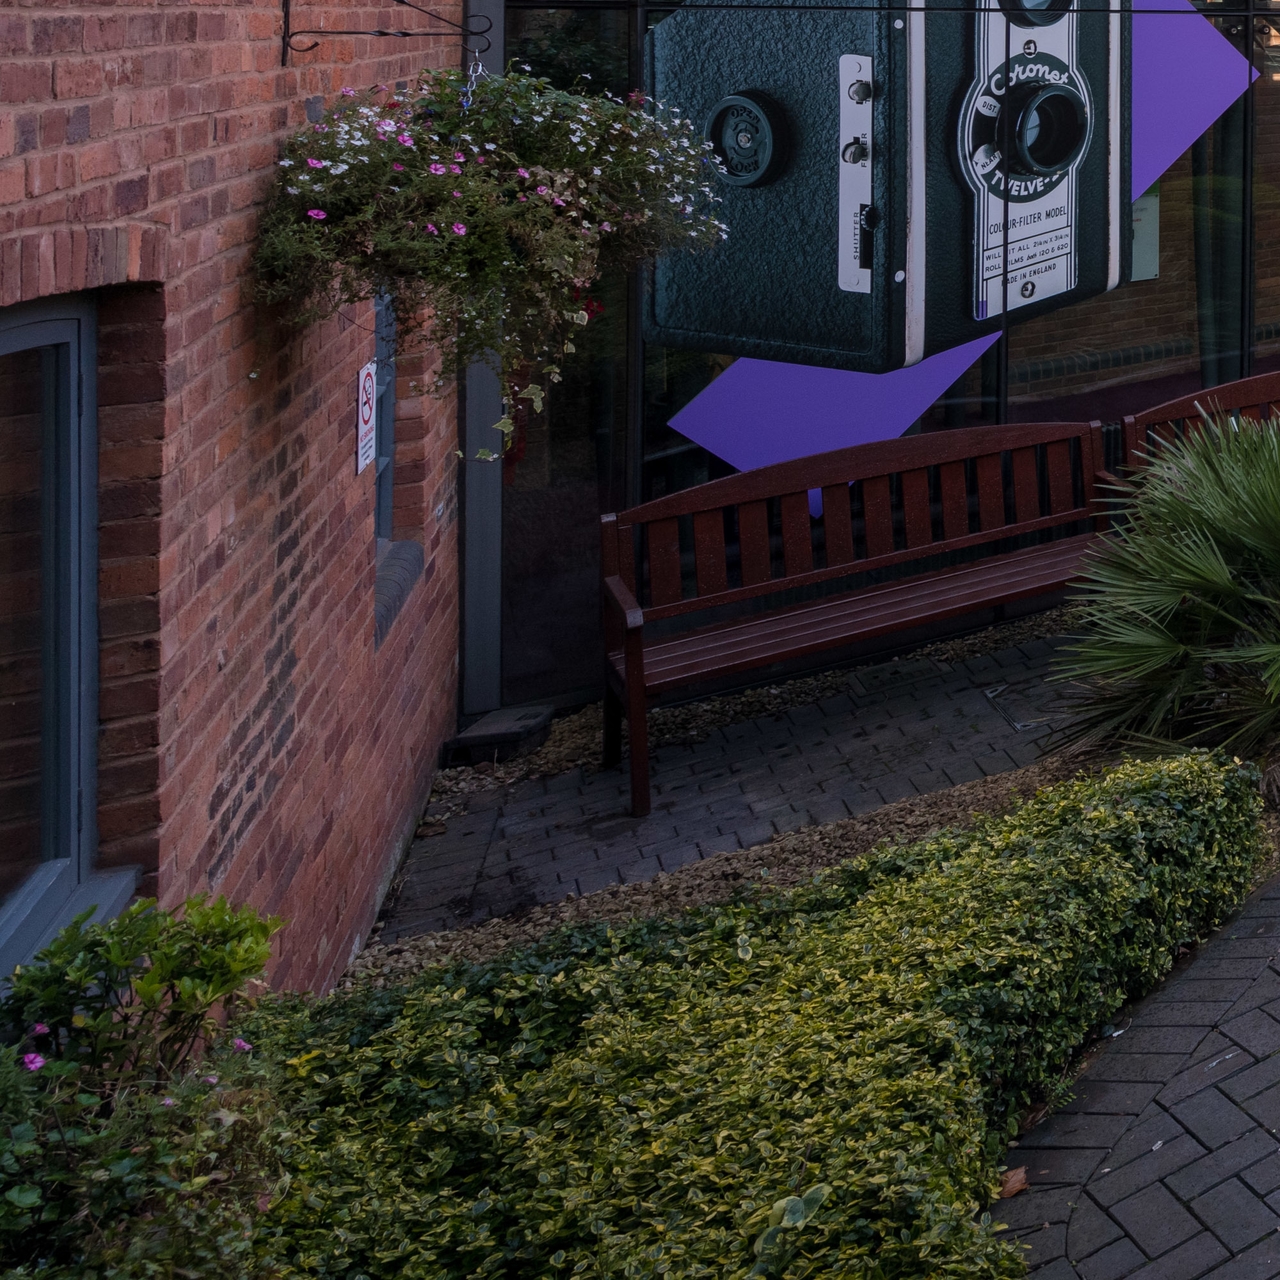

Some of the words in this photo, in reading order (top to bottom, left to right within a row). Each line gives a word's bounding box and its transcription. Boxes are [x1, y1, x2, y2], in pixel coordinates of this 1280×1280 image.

[730, 106, 761, 123] OPEN
[982, 100, 997, 114] DIST.
[729, 157, 760, 172] LOCK
[981, 154, 998, 170] NEAR
[1045, 205, 1067, 219] MODEL
[985, 253, 1002, 261] WILL
[1017, 243, 1030, 252] ALL
[985, 263, 1002, 273] ROLL
[1039, 249, 1050, 257] 120
[1057, 242, 1069, 251] 620
[1020, 272, 1027, 280] IN
[1029, 263, 1057, 277] ENGLAND
